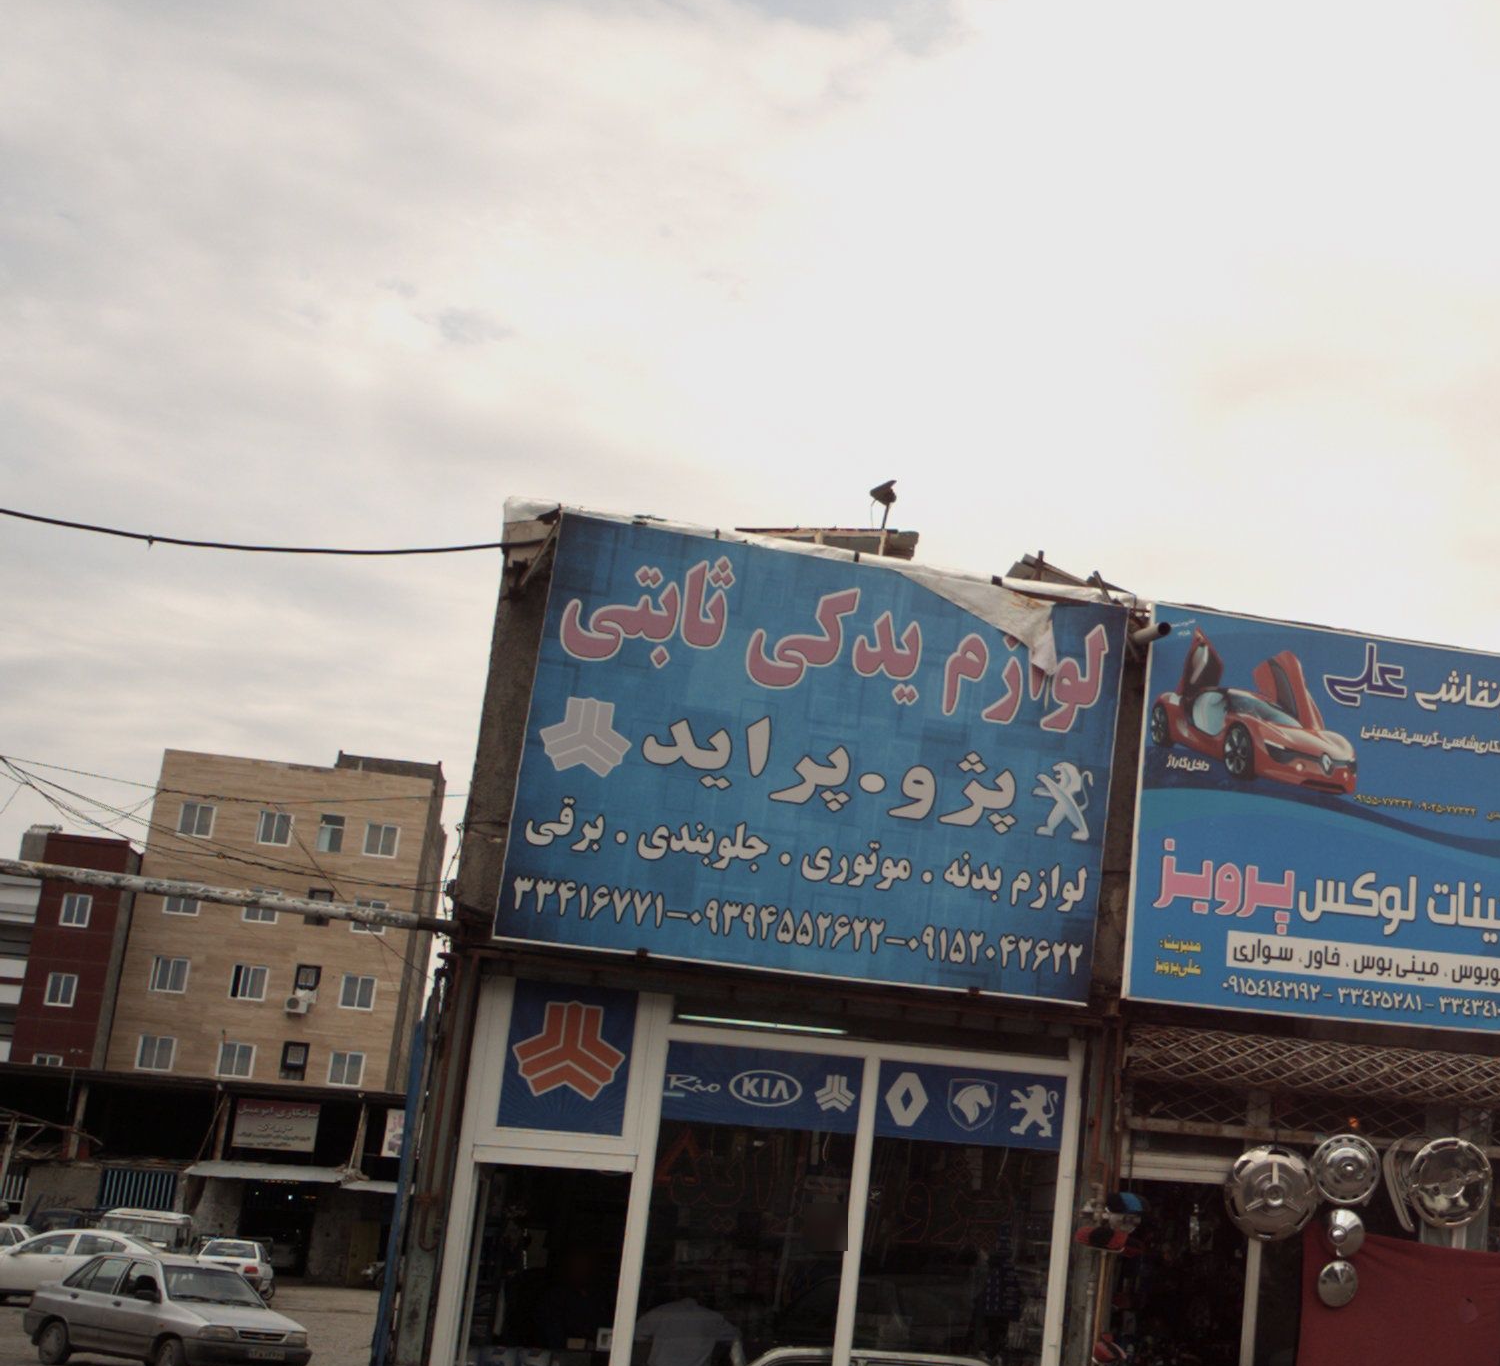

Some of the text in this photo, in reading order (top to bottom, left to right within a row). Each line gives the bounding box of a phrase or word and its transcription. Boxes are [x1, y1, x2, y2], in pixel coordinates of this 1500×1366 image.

[560, 556, 736, 668] ثابتی
[747, 588, 921, 704] یدکی
[1324, 642, 1407, 707] علی
[888, 751, 1017, 834] پژو
[525, 796, 1088, 913] لوازم بدنه موتوری جلوبندی برقی
[1152, 837, 1296, 936] پرویز
[1299, 871, 1418, 935] لوکس
[1232, 939, 1294, 964] سواری
[1303, 946, 1340, 968] خاور
[1352, 952, 1393, 978] بوس
[1395, 953, 1440, 982] مینی
[667, 1073, 790, 1100] Rio KIA
